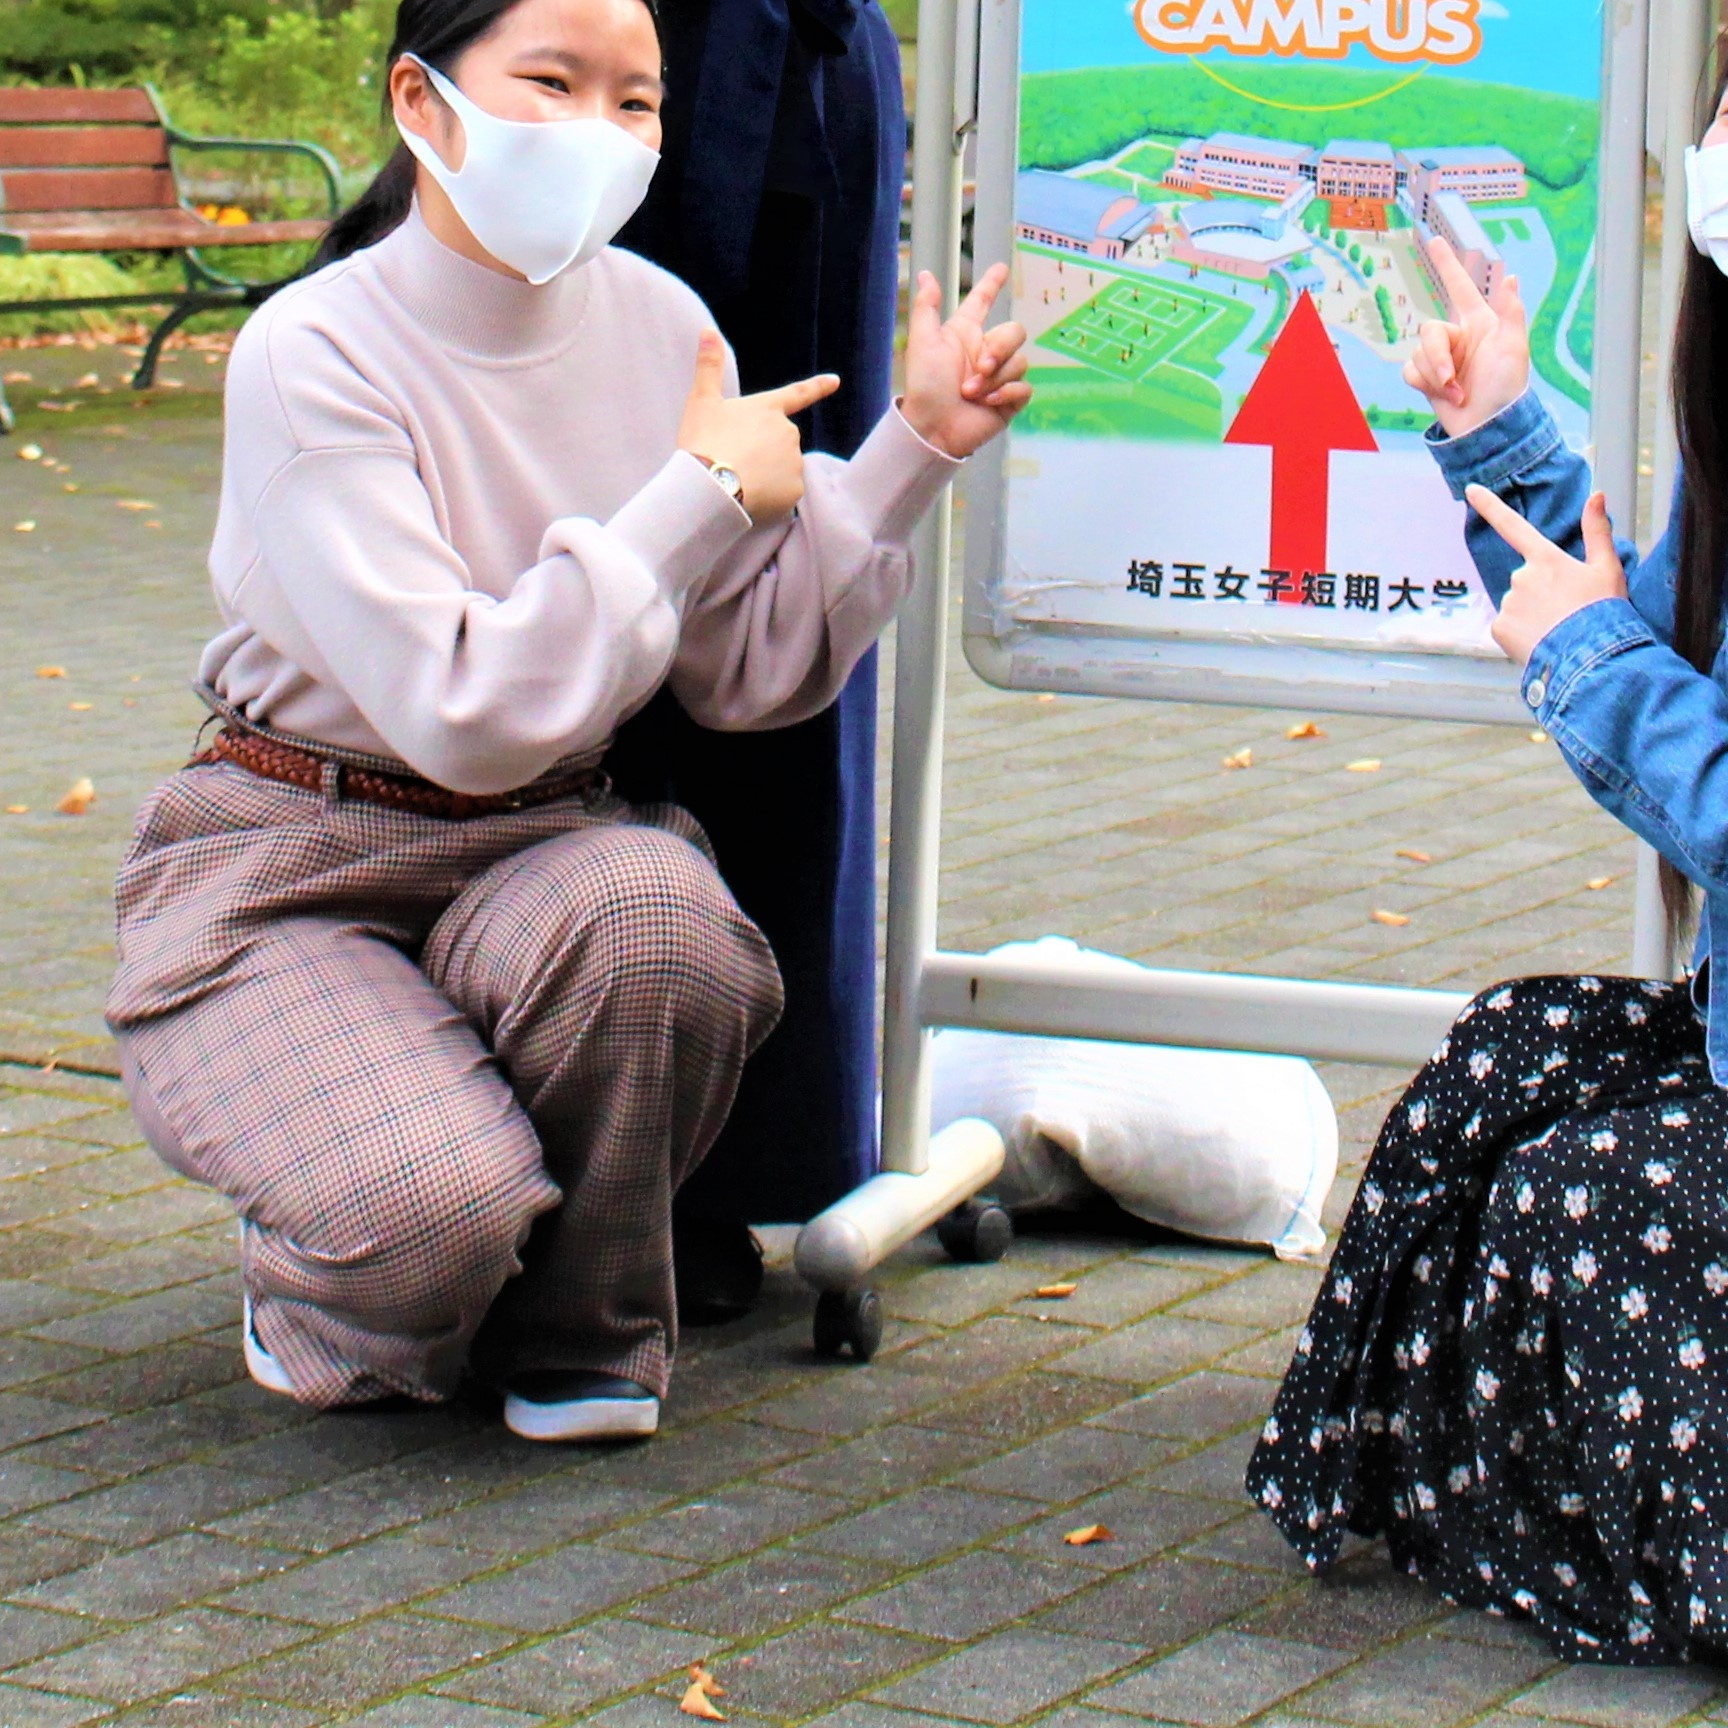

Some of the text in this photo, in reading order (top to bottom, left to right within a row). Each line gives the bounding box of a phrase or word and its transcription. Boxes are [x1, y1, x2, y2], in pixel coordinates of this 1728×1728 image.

[1125, 558, 1470, 617] 埼玉女子短期大学
